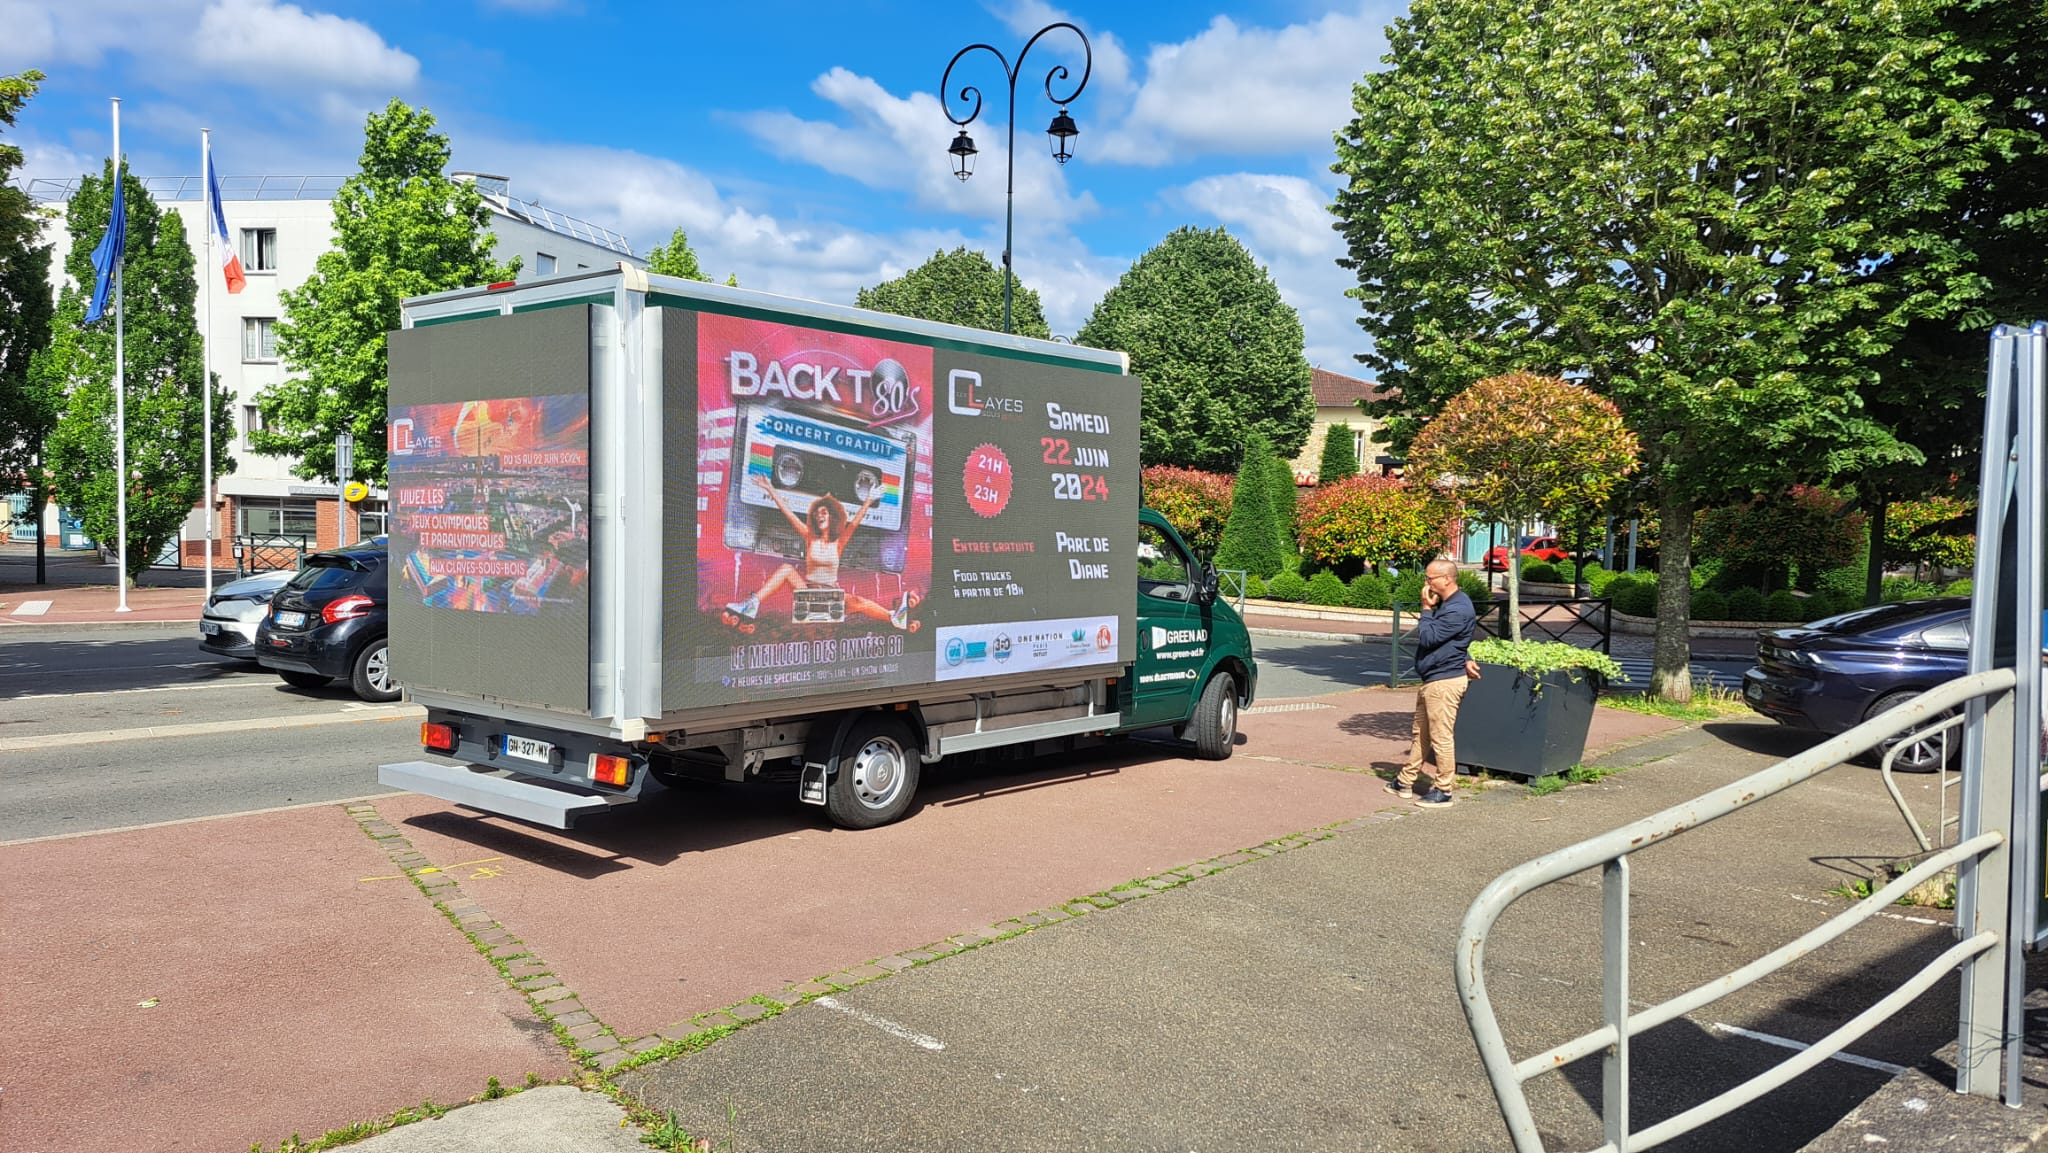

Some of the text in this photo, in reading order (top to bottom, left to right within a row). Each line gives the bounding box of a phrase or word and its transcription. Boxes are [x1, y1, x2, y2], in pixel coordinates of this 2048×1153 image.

[729, 349, 842, 402] BACK
[1046, 402, 1110, 435] SAMEDI
[763, 418, 893, 456] CONCERT GRATUIT
[1040, 437, 1110, 468] 22 JUIN
[978, 454, 1003, 474] 21H
[974, 484, 998, 504] 23H
[1051, 472, 1110, 502] 2024
[400, 488, 444, 505] VIVEZ LES
[412, 515, 489, 530] JEUX OLYMPIQUES
[420, 533, 504, 548] ET PARALYMPIQUES
[993, 540, 1035, 553] GRATUITE
[1055, 531, 1110, 553] PARC DE
[430, 562, 445, 574] AUX
[953, 569, 1012, 582] FOOD TRUCKS
[1068, 559, 1109, 580] DIANE
[962, 588, 991, 598] PARTIR
[994, 587, 1004, 596] DE
[1006, 584, 1024, 596] 18H
[1017, 632, 1063, 643] ONE NATION
[1167, 629, 1208, 644] GREEN AD
[730, 632, 904, 670] LE MEILLEUR DES ANNÉES 80
[1156, 648, 1205, 660] www.green-ad.fr
